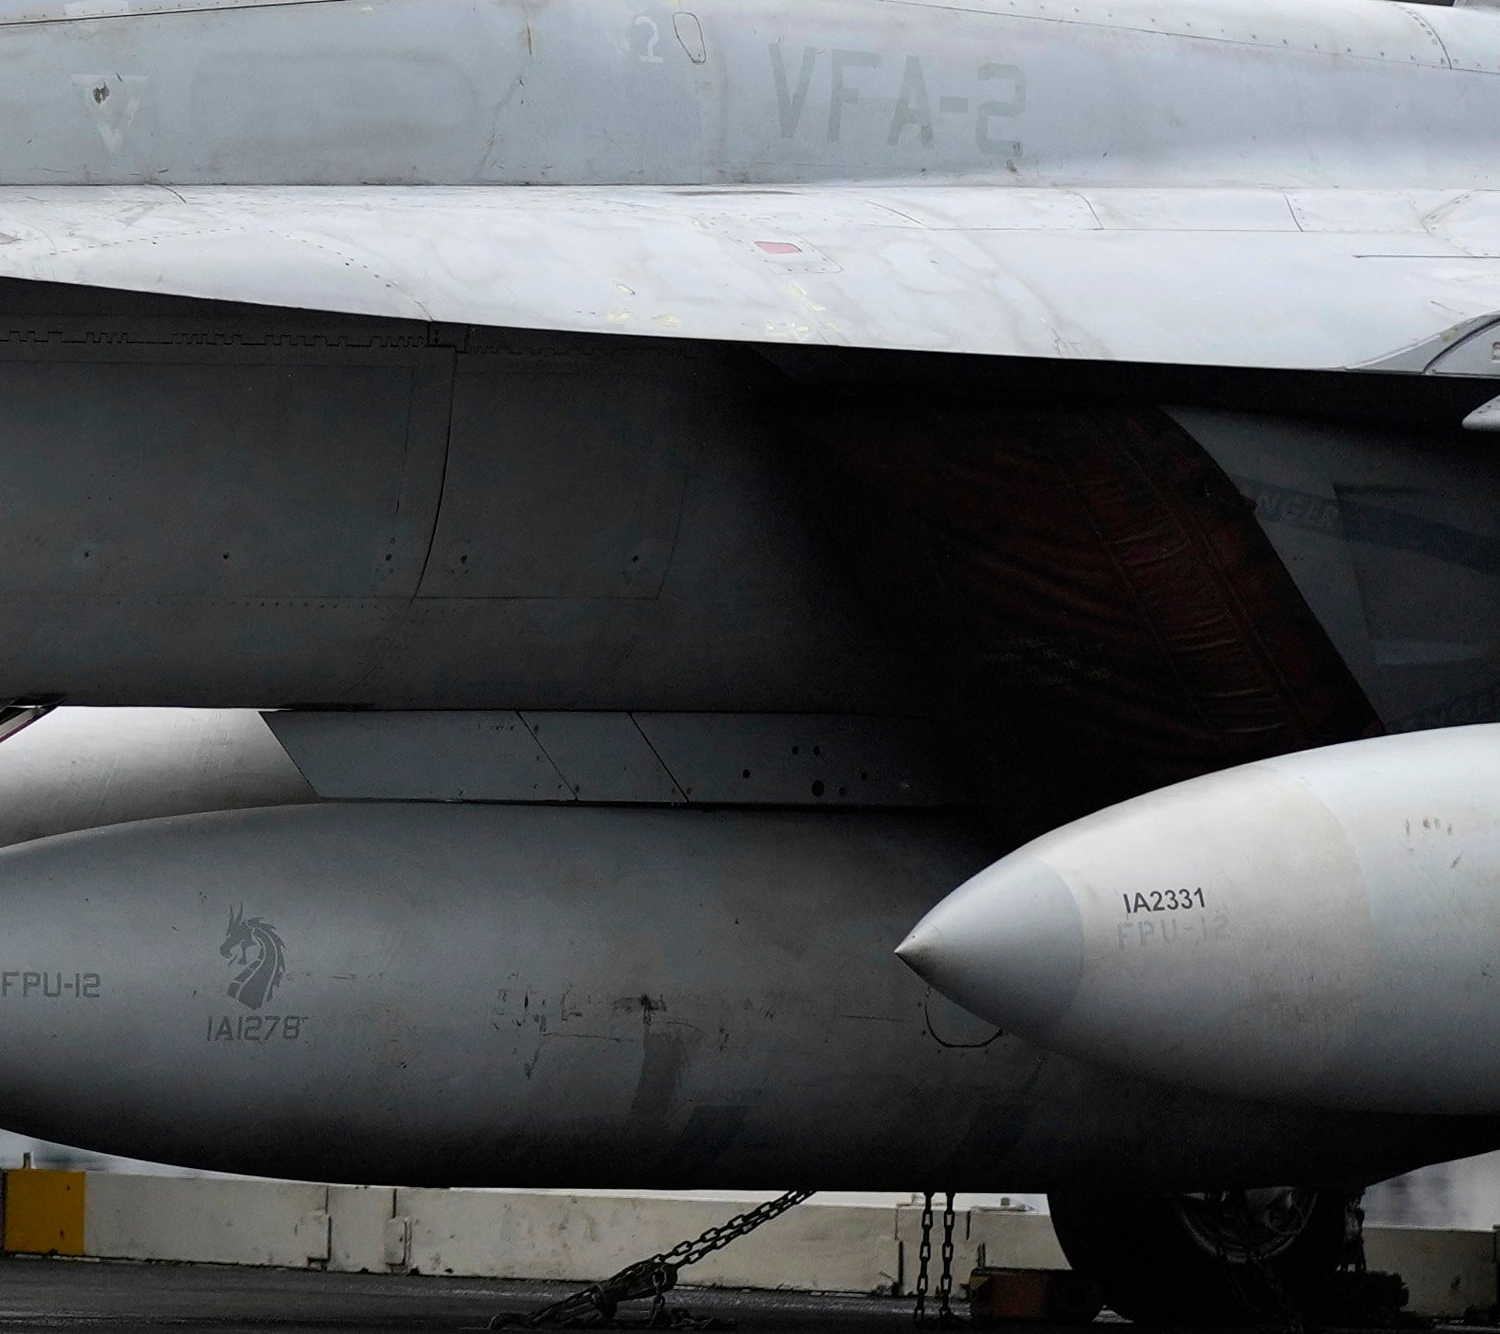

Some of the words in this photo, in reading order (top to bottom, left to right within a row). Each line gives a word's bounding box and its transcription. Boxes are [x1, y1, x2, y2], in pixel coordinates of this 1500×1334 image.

[767, 43, 1027, 158] VFA-2
[1123, 887, 1205, 914] IA2331
[1, 971, 100, 998] FPU-12
